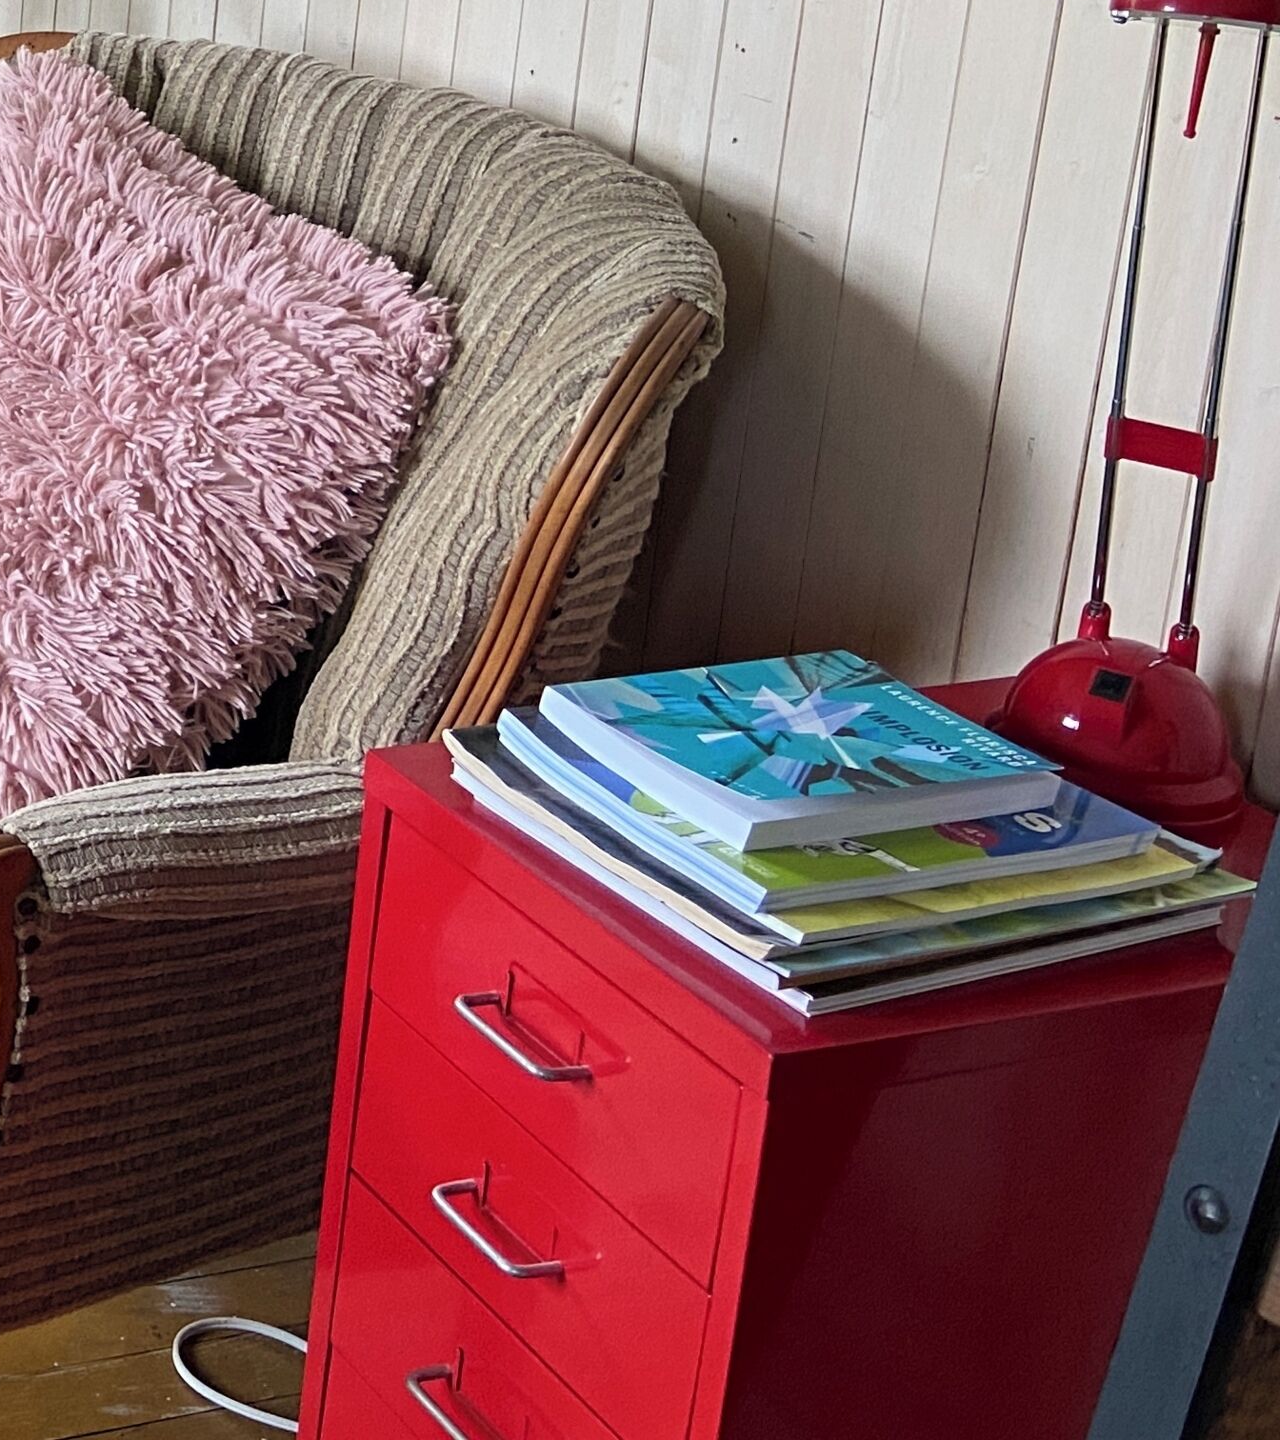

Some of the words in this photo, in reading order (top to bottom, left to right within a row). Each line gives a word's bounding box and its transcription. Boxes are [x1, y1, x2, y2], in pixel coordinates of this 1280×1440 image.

[879, 684, 960, 726] LAURENCE
[861, 708, 990, 772] IMPLOSION
[960, 738, 1024, 768] RIVARD
